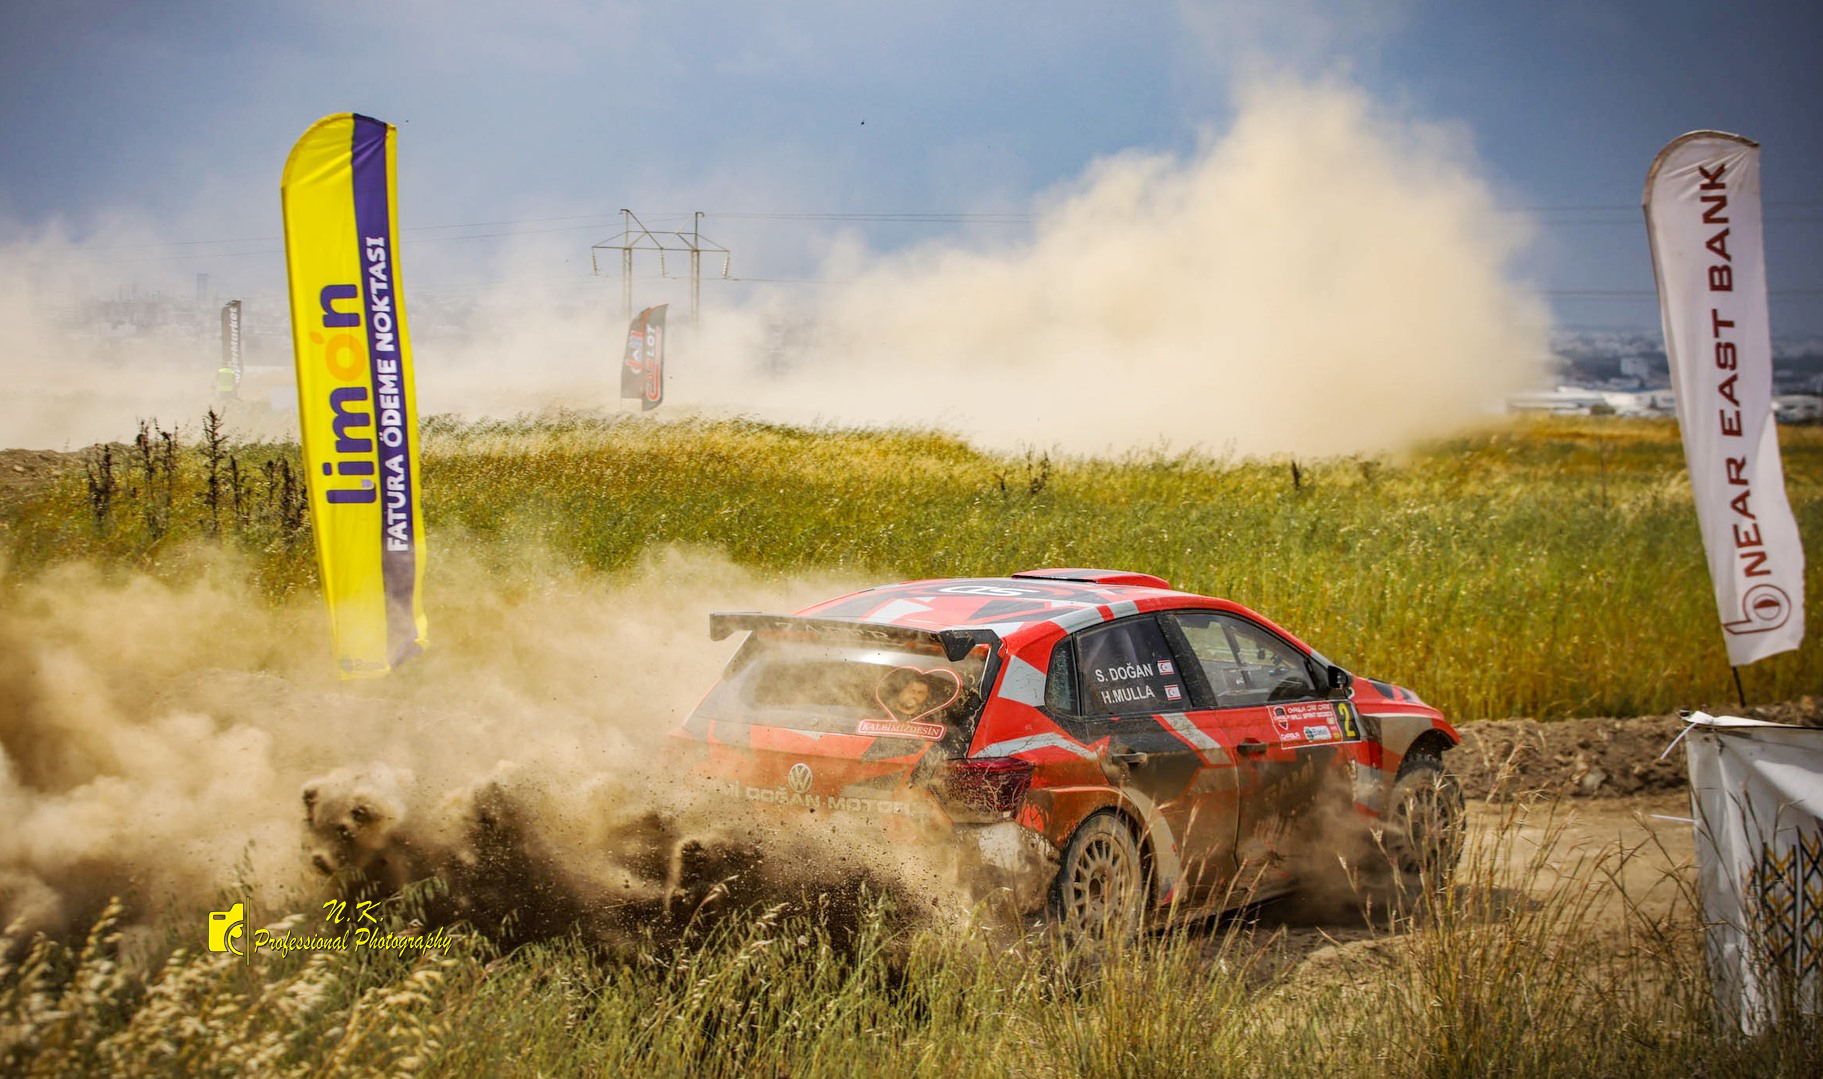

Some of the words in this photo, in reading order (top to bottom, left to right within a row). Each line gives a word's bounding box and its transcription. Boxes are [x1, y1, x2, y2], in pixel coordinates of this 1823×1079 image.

[1699, 163, 1734, 292] BANK
[365, 236, 396, 352] NOKTASI
[375, 358, 404, 448] ÖDEME
[1712, 308, 1743, 438] EAST
[384, 454, 409, 552] FATURA
[1725, 455, 1772, 578] NEAR
[1094, 669, 1109, 682] S.
[1108, 662, 1154, 681] DOĞAN
[1337, 702, 1356, 738] 2
